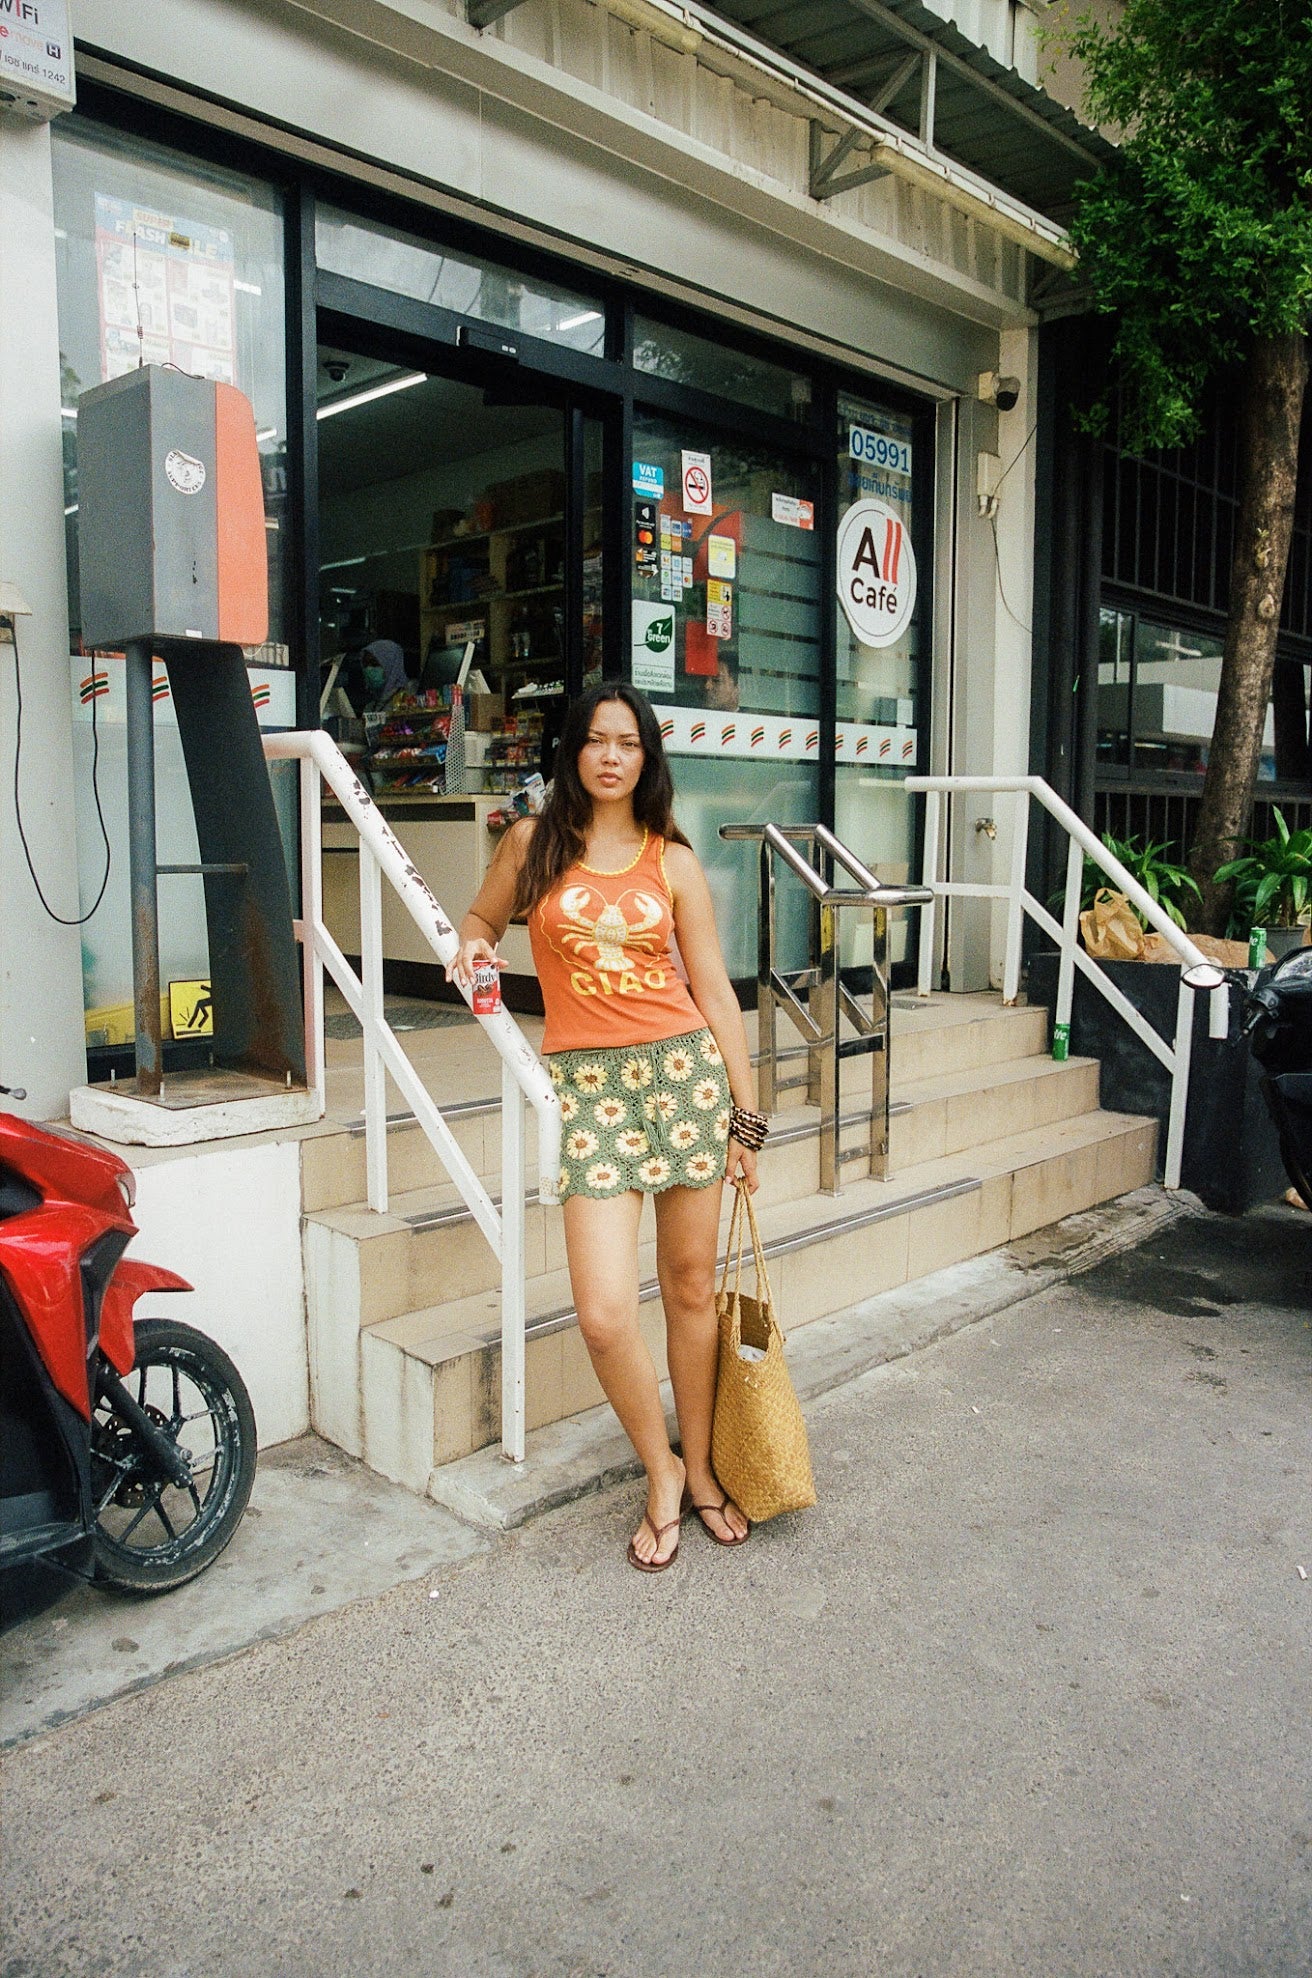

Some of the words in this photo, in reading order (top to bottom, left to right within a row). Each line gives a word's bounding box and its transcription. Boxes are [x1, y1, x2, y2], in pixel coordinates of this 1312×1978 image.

[42, 68, 65, 84] 1242
[852, 430, 909, 472] 05991
[639, 464, 657, 478] VAT
[850, 577, 898, 614] Café
[656, 622, 664, 635] 7
[647, 633, 671, 644] Green
[570, 969, 666, 996] CIAO
